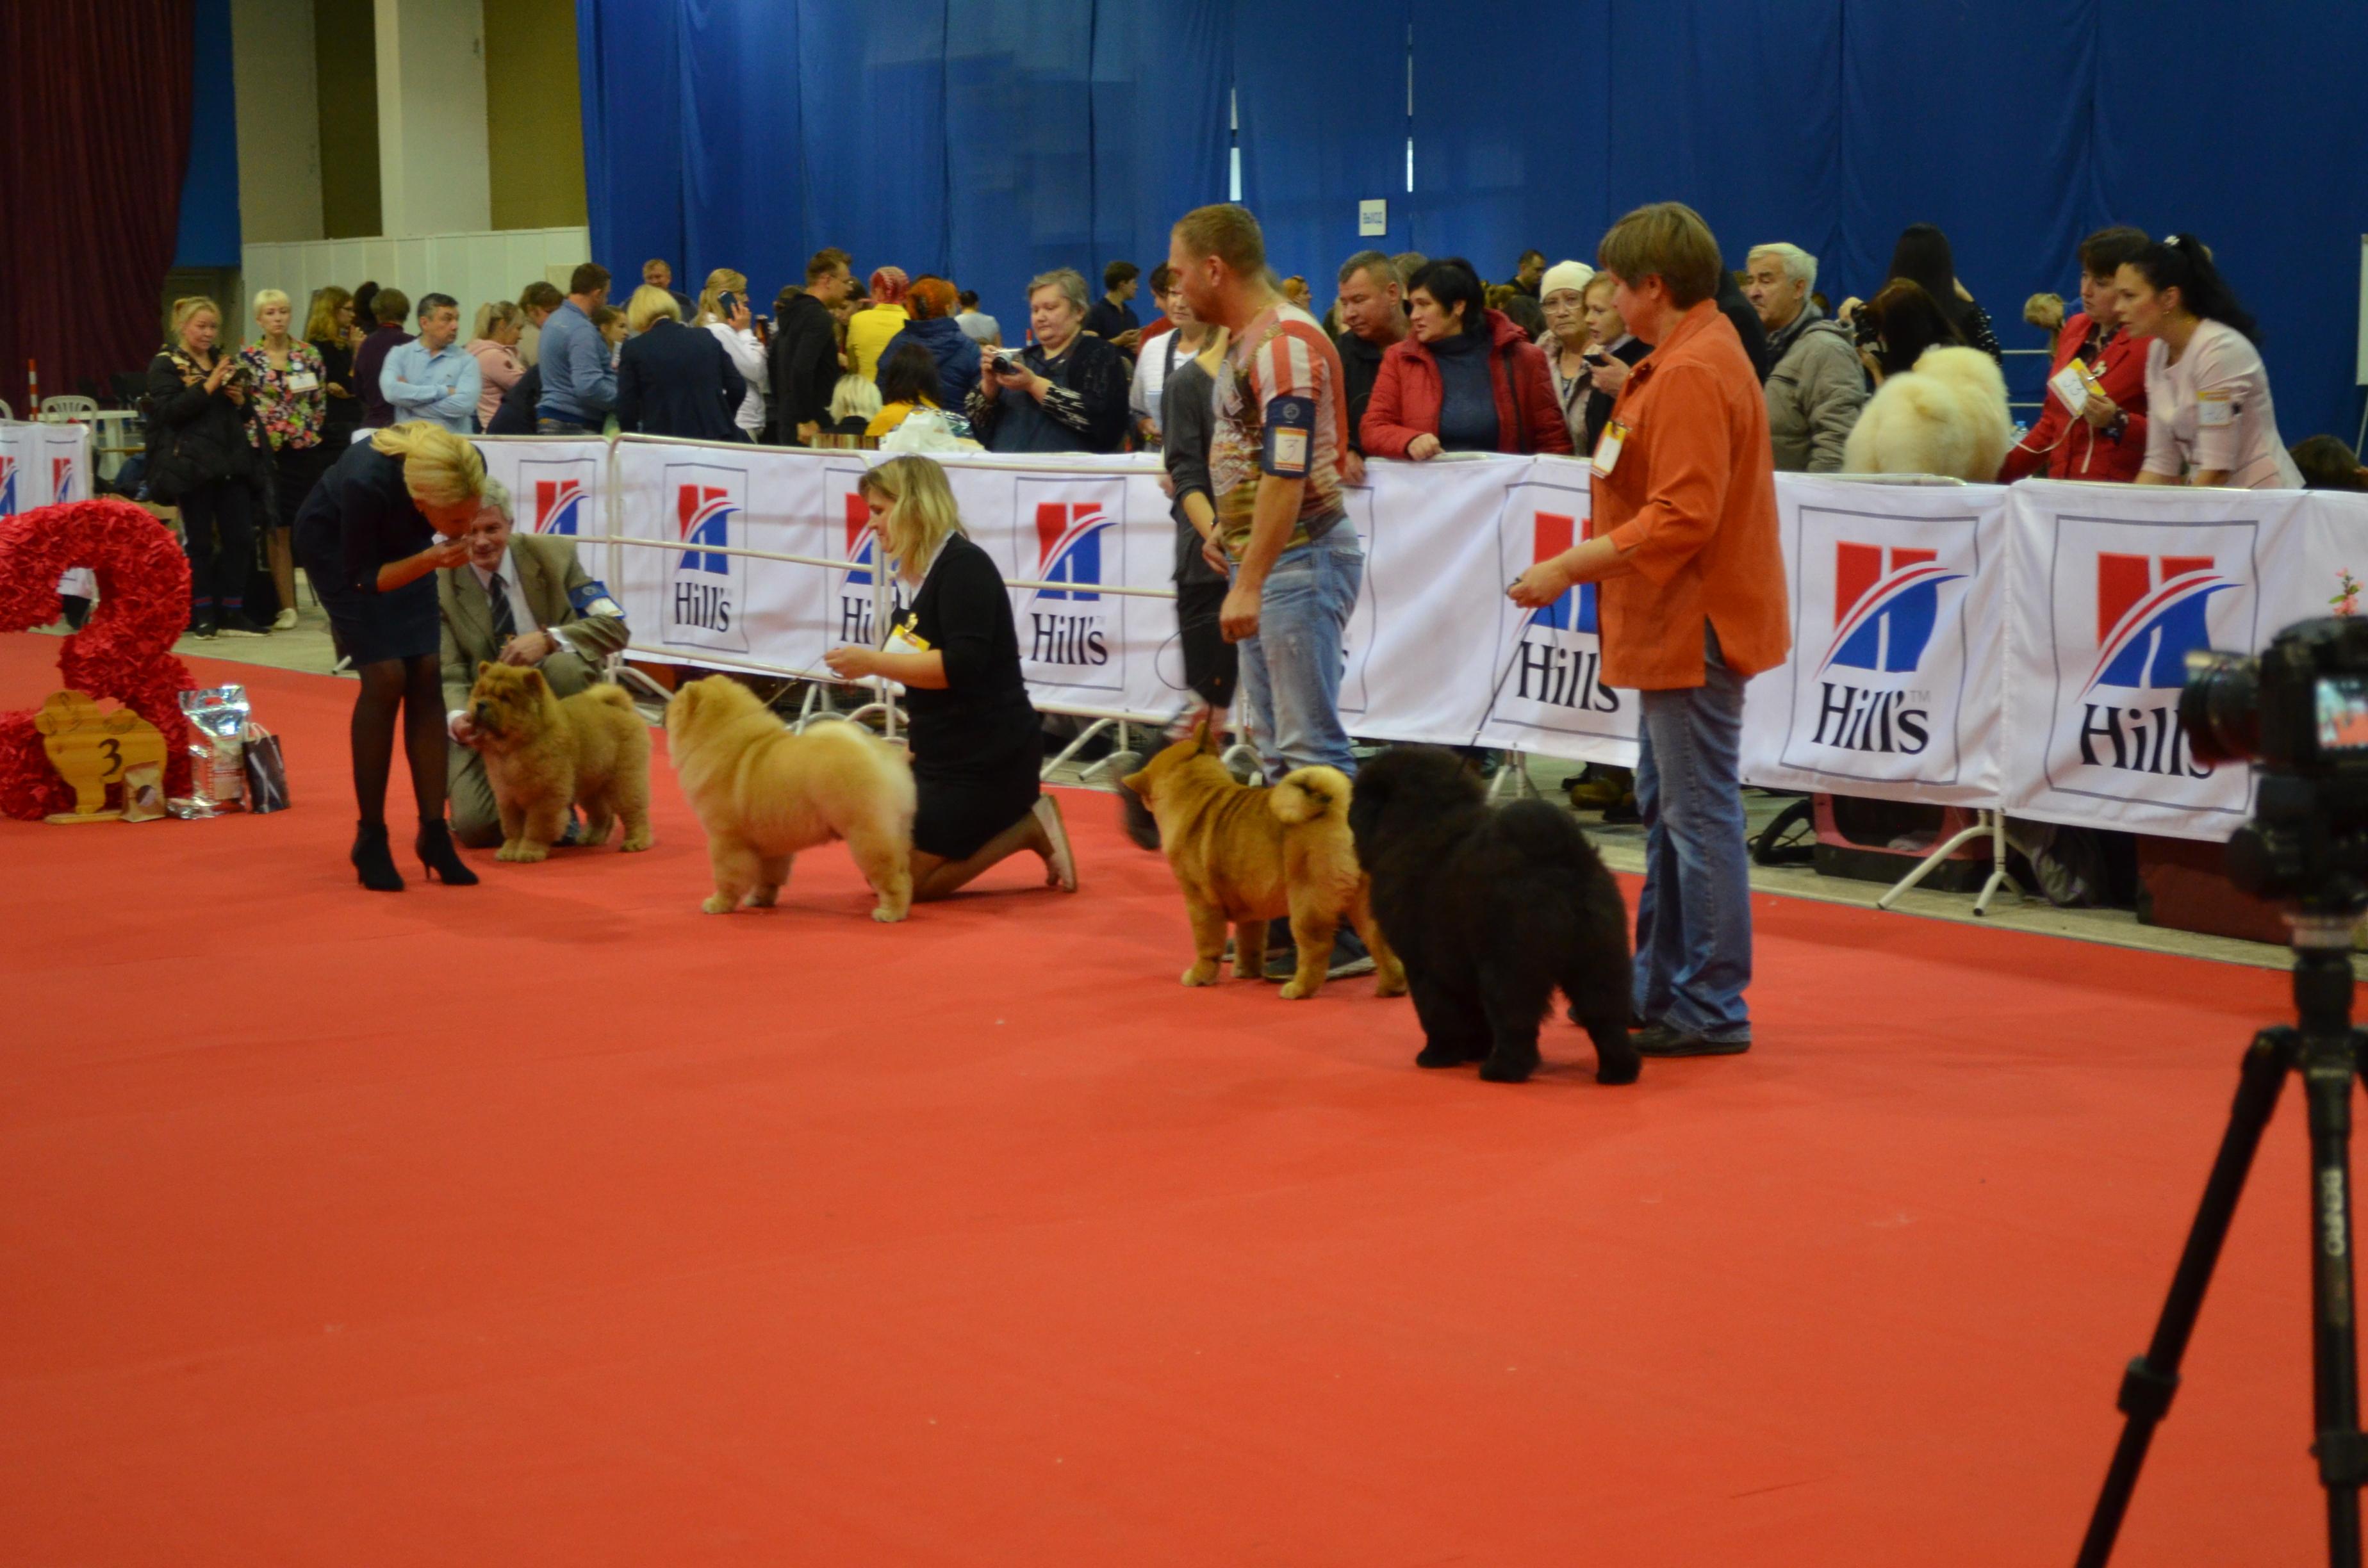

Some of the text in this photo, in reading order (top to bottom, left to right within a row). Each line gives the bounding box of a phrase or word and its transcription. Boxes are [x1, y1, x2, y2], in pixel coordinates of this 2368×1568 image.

[675, 582, 731, 633] Hill's
[1030, 612, 1108, 666] Hill's
[1811, 682, 1929, 755] Hill's
[97, 738, 122, 777] 3
